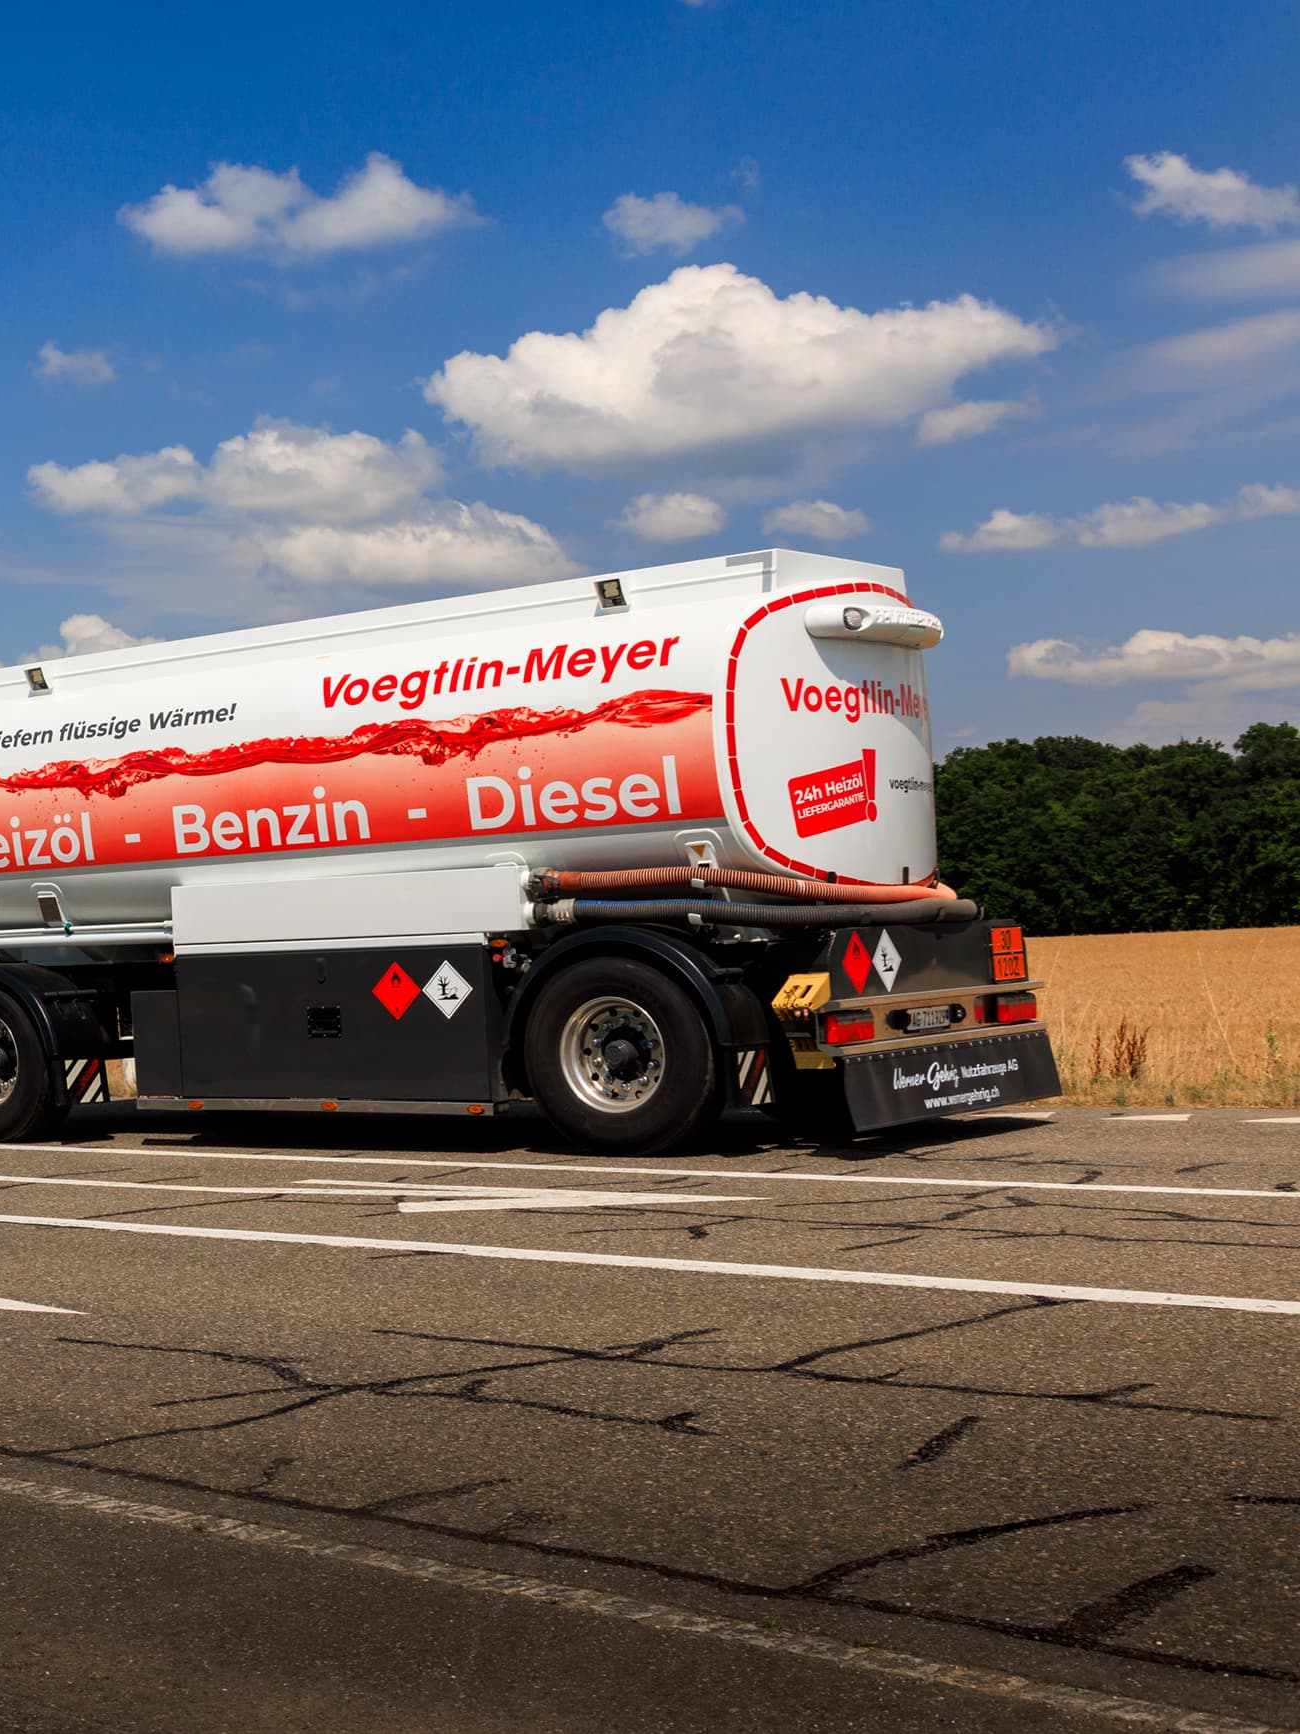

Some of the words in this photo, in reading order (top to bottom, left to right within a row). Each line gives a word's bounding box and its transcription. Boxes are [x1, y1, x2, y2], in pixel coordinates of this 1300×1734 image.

[321, 635, 680, 711] Voegtlin-Meyer
[59, 715, 141, 742] flüssige
[149, 703, 237, 730] Wärme!
[172, 785, 371, 854] Benzin
[466, 754, 683, 831] Diesel
[794, 785, 823, 806] 24h
[825, 772, 863, 797] Heizöl
[797, 791, 866, 819] LIEFERGARANTIE
[893, 1067, 925, 1090] Werner
[961, 1063, 1007, 1079] Nutzfahrzeuge
[1008, 1058, 1019, 1072] AG
